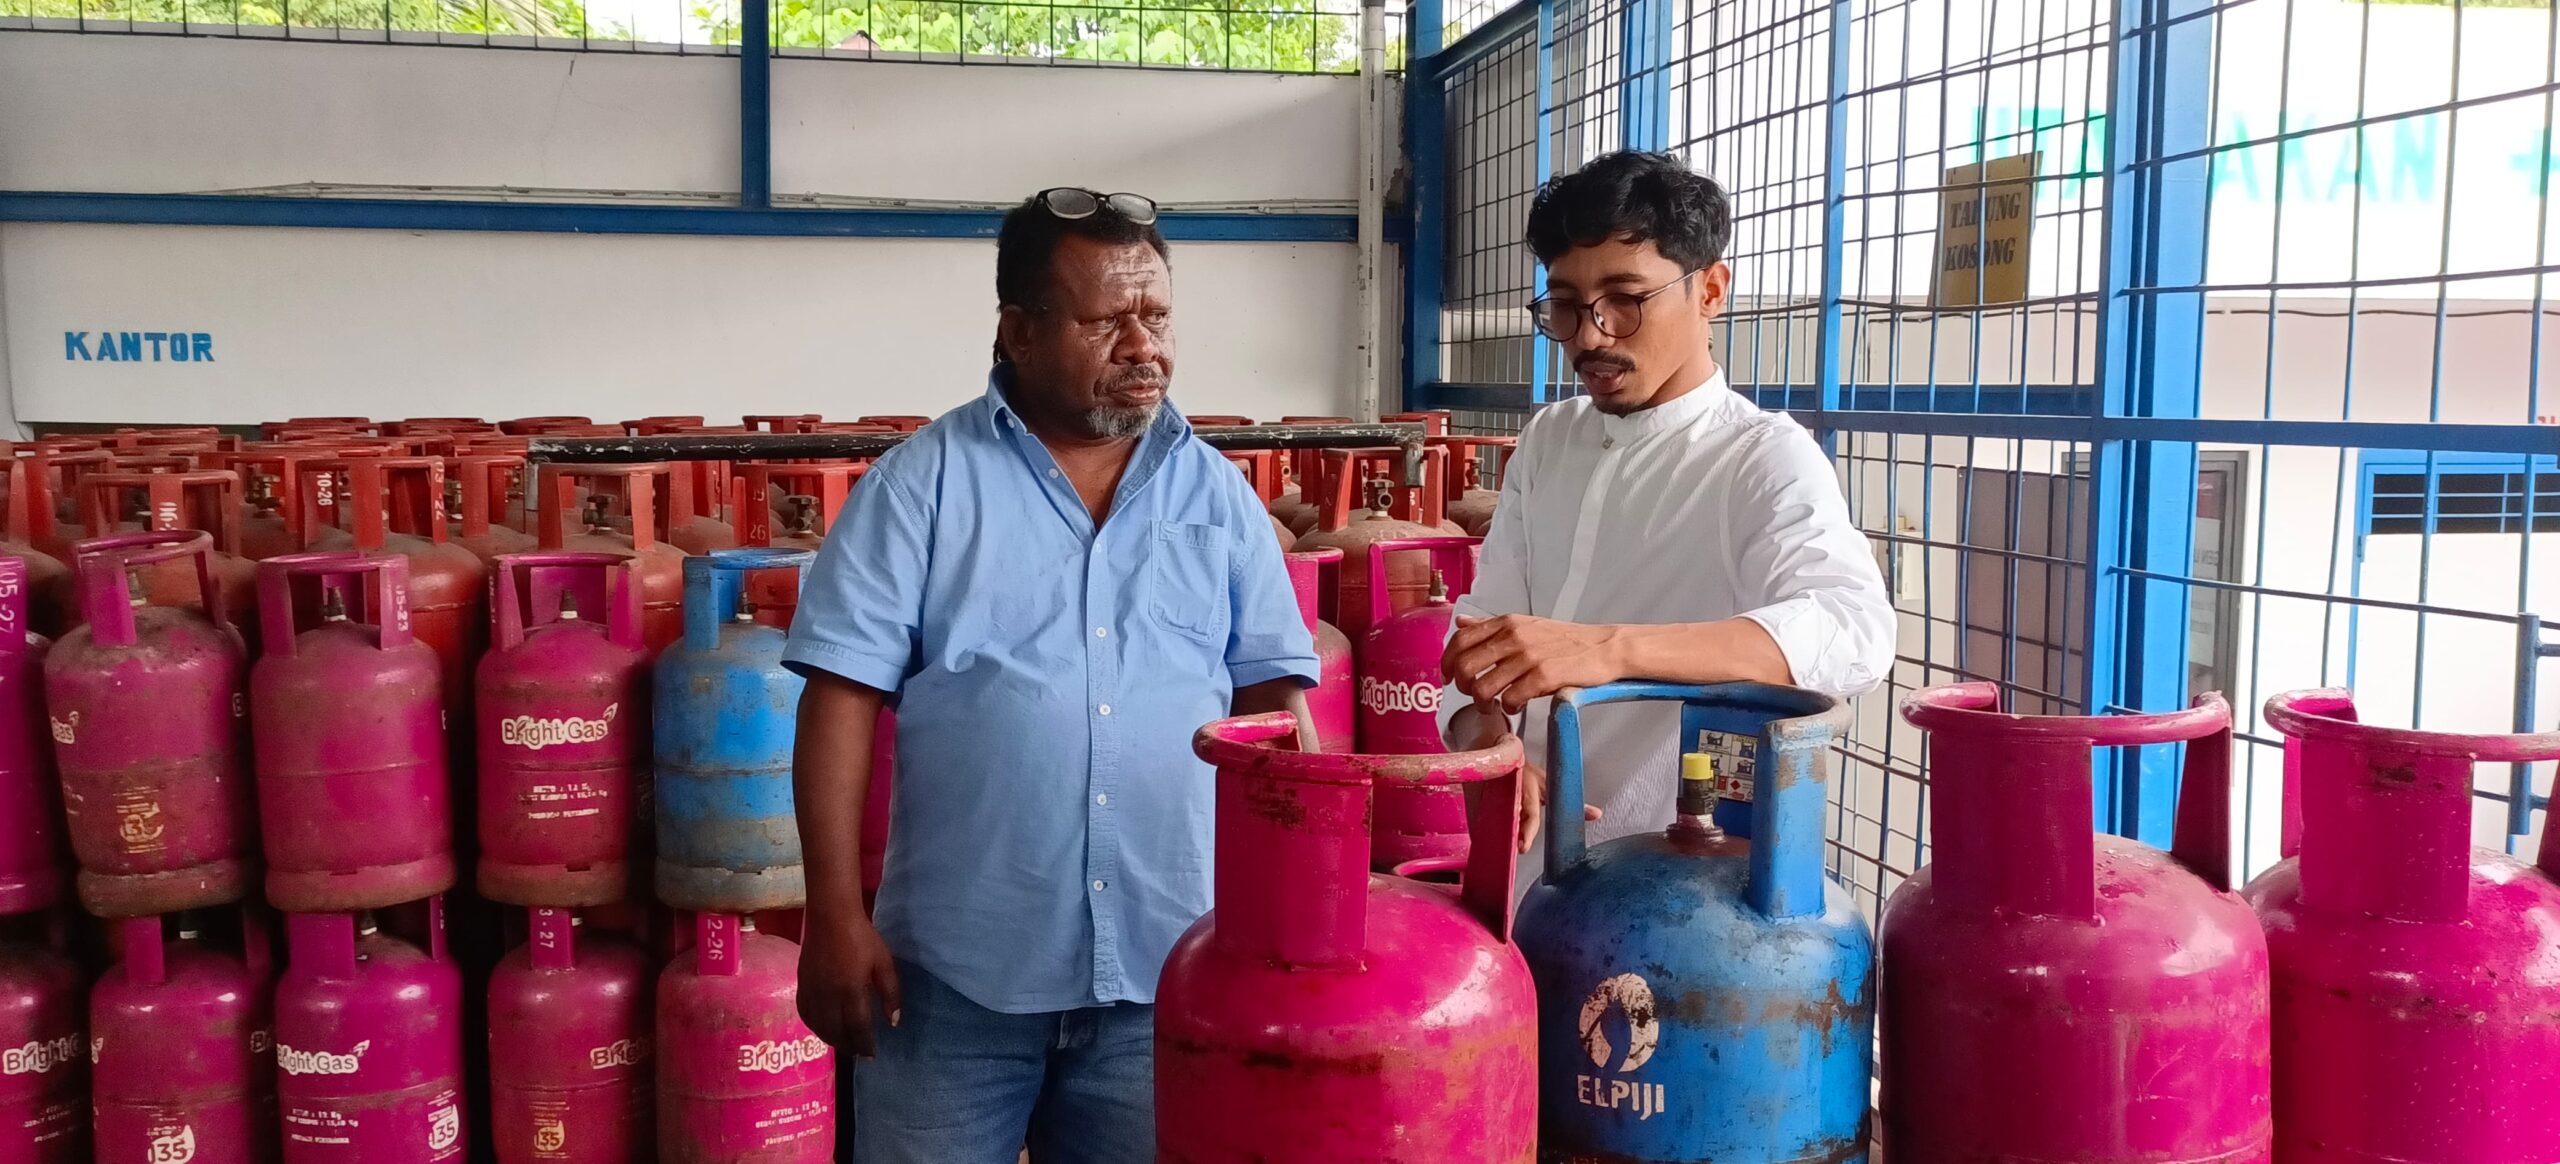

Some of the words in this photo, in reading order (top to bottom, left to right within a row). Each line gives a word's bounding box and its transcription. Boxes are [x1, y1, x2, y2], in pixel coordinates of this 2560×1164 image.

[65, 331, 215, 362] KANTOR
[1361, 677, 1412, 714] right
[502, 715, 565, 749] Bright
[565, 716, 608, 743] Gas
[708, 914, 724, 960] 2-26
[314, 1051, 358, 1074] Gas
[738, 1040, 802, 1074] Bright
[1576, 1074, 1665, 1121] ELPIJI
